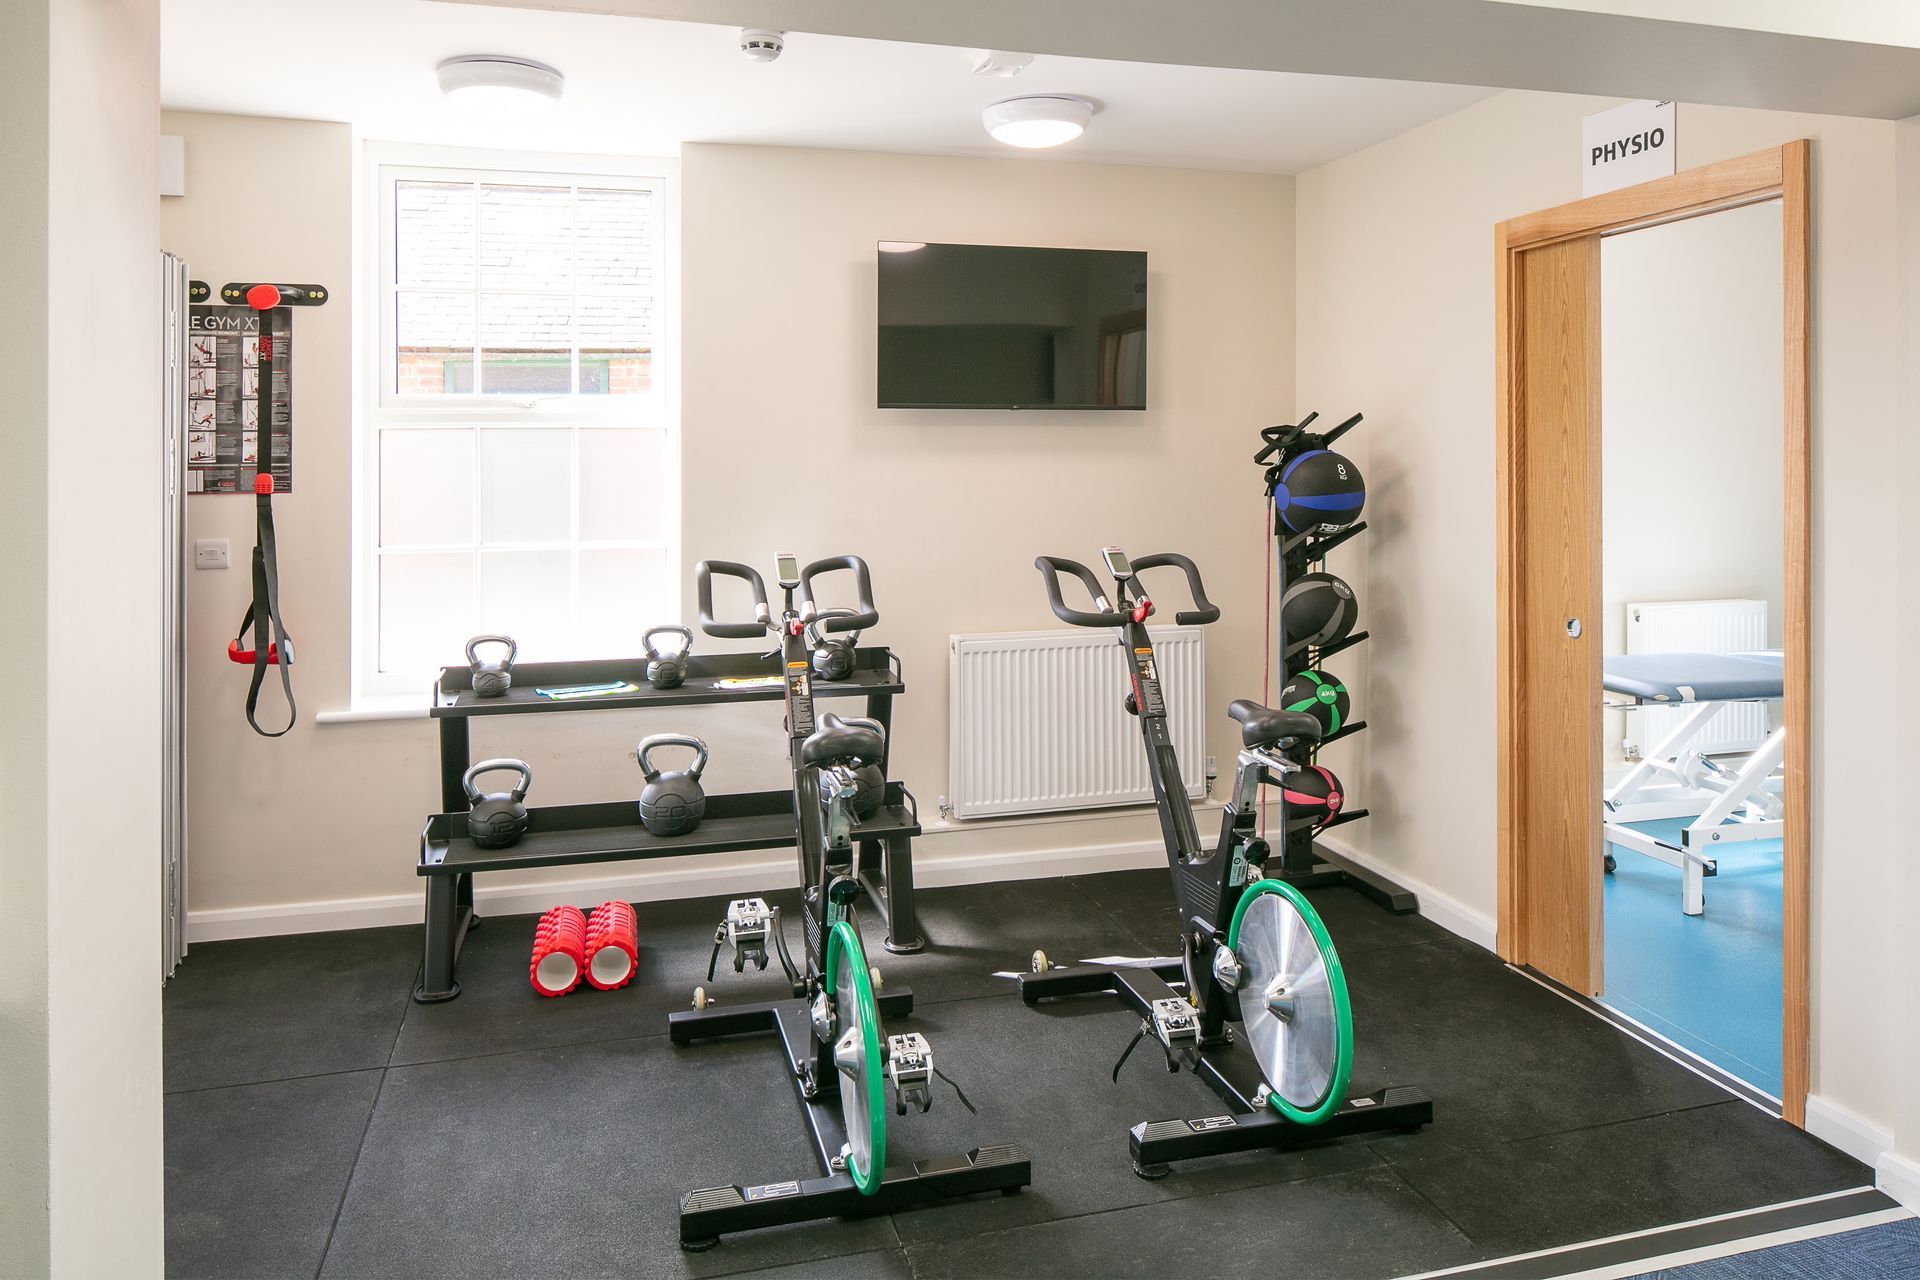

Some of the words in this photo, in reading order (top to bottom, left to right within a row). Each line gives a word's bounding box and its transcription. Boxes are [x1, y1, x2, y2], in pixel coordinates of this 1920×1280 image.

[1591, 127, 1665, 166] PHYSIO
[204, 316, 240, 330] GYM
[260, 351, 266, 361] XT
[1337, 463, 1346, 475] 8
